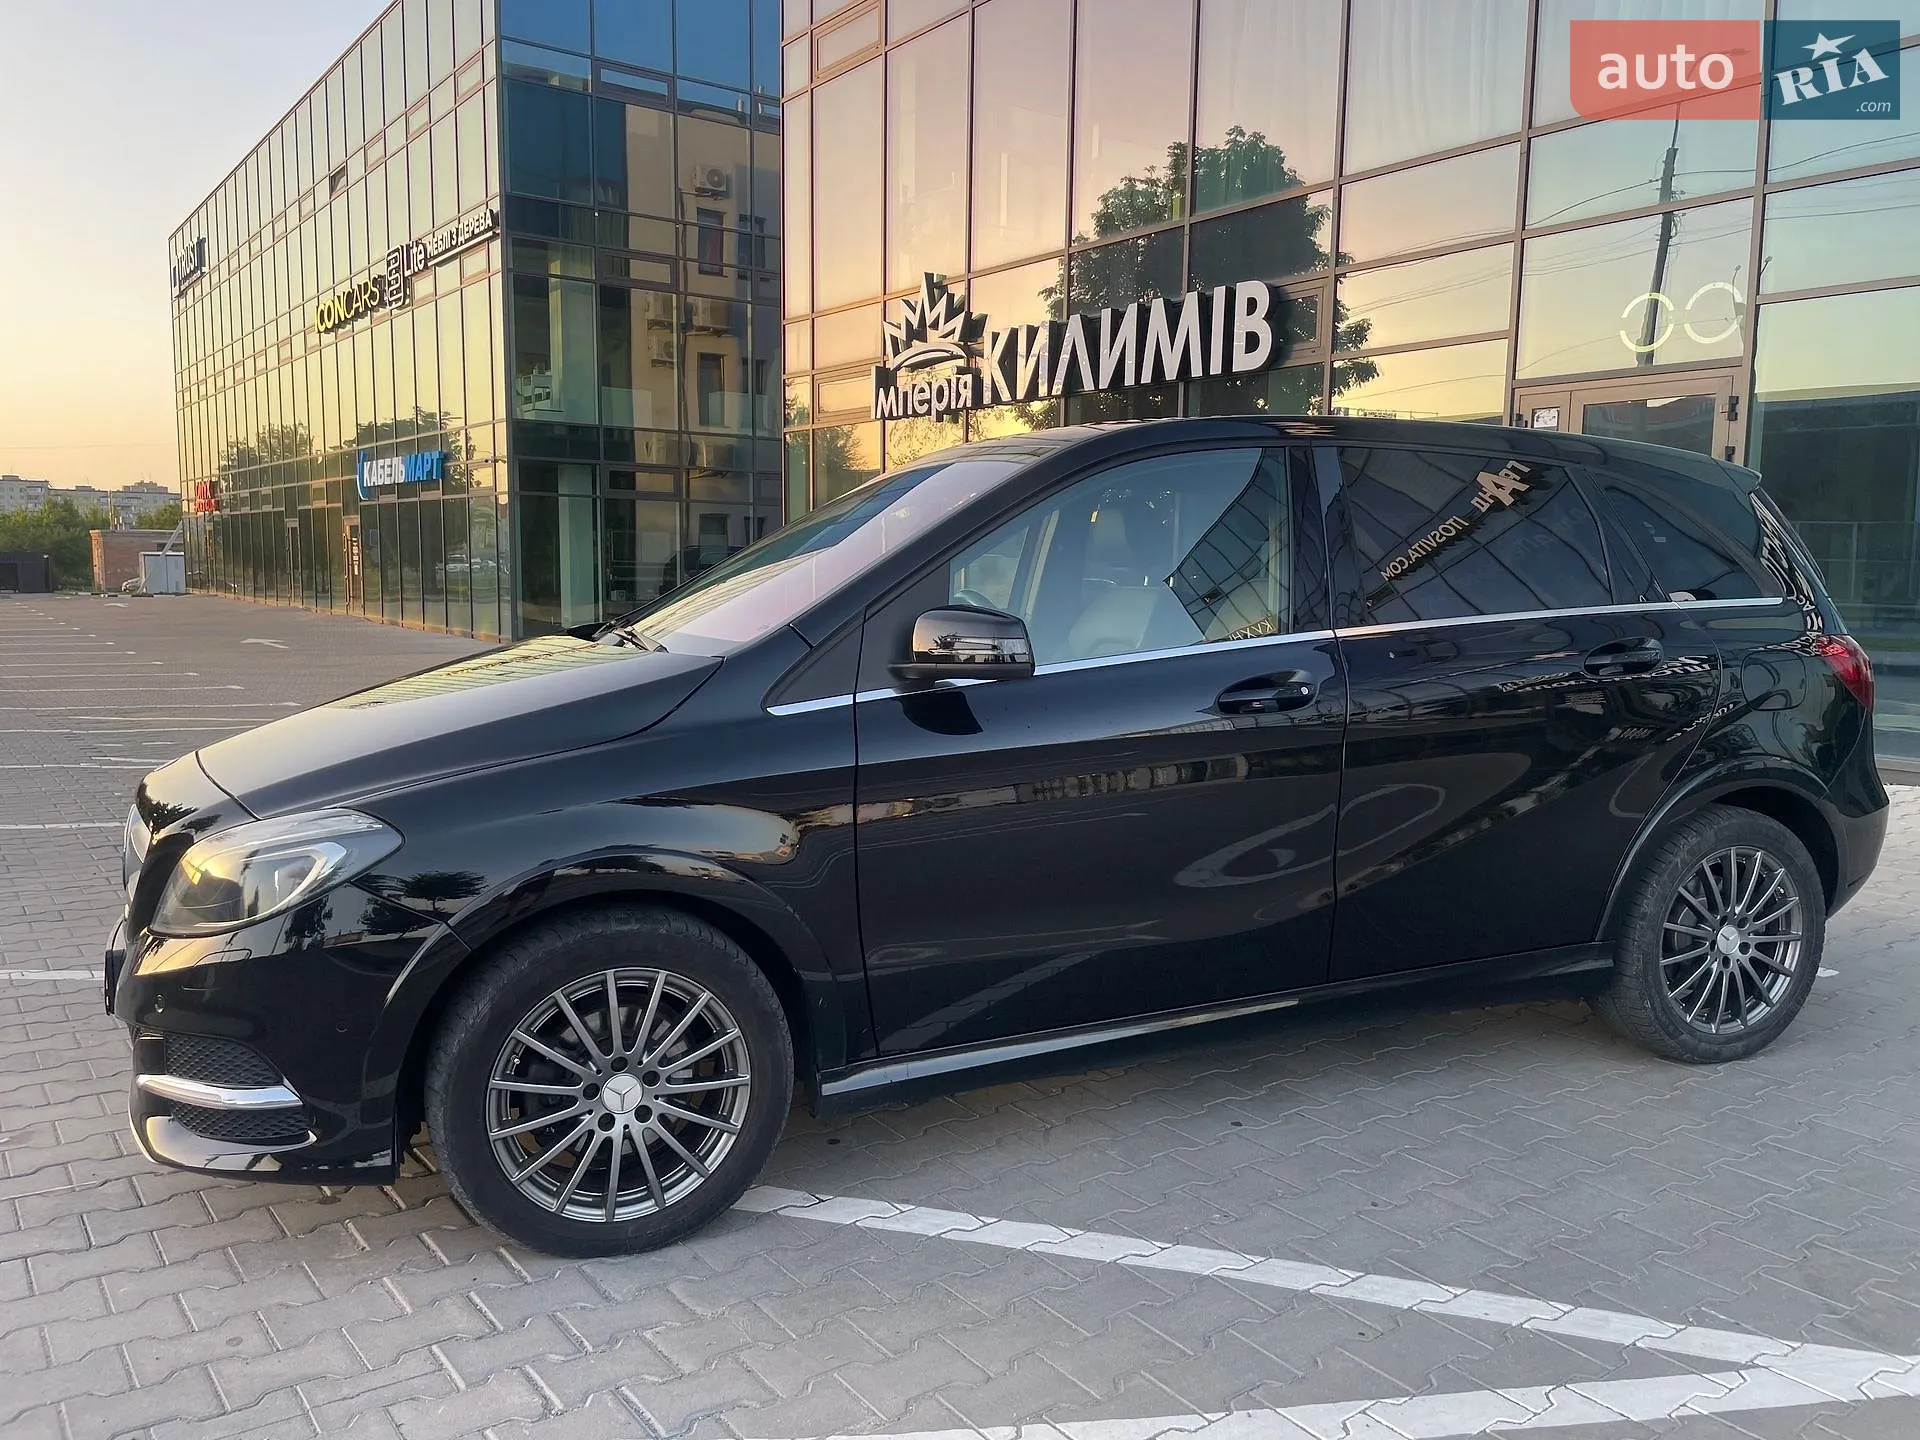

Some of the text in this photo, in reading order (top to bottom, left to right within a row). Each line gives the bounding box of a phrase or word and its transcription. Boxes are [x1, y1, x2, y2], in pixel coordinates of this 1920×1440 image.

[403, 241, 425, 277] Lite
[426, 229, 451, 259] МЕБЛІ
[457, 208, 493, 247] ДЕРЕВА
[982, 280, 1273, 405] КИЛИМІВ
